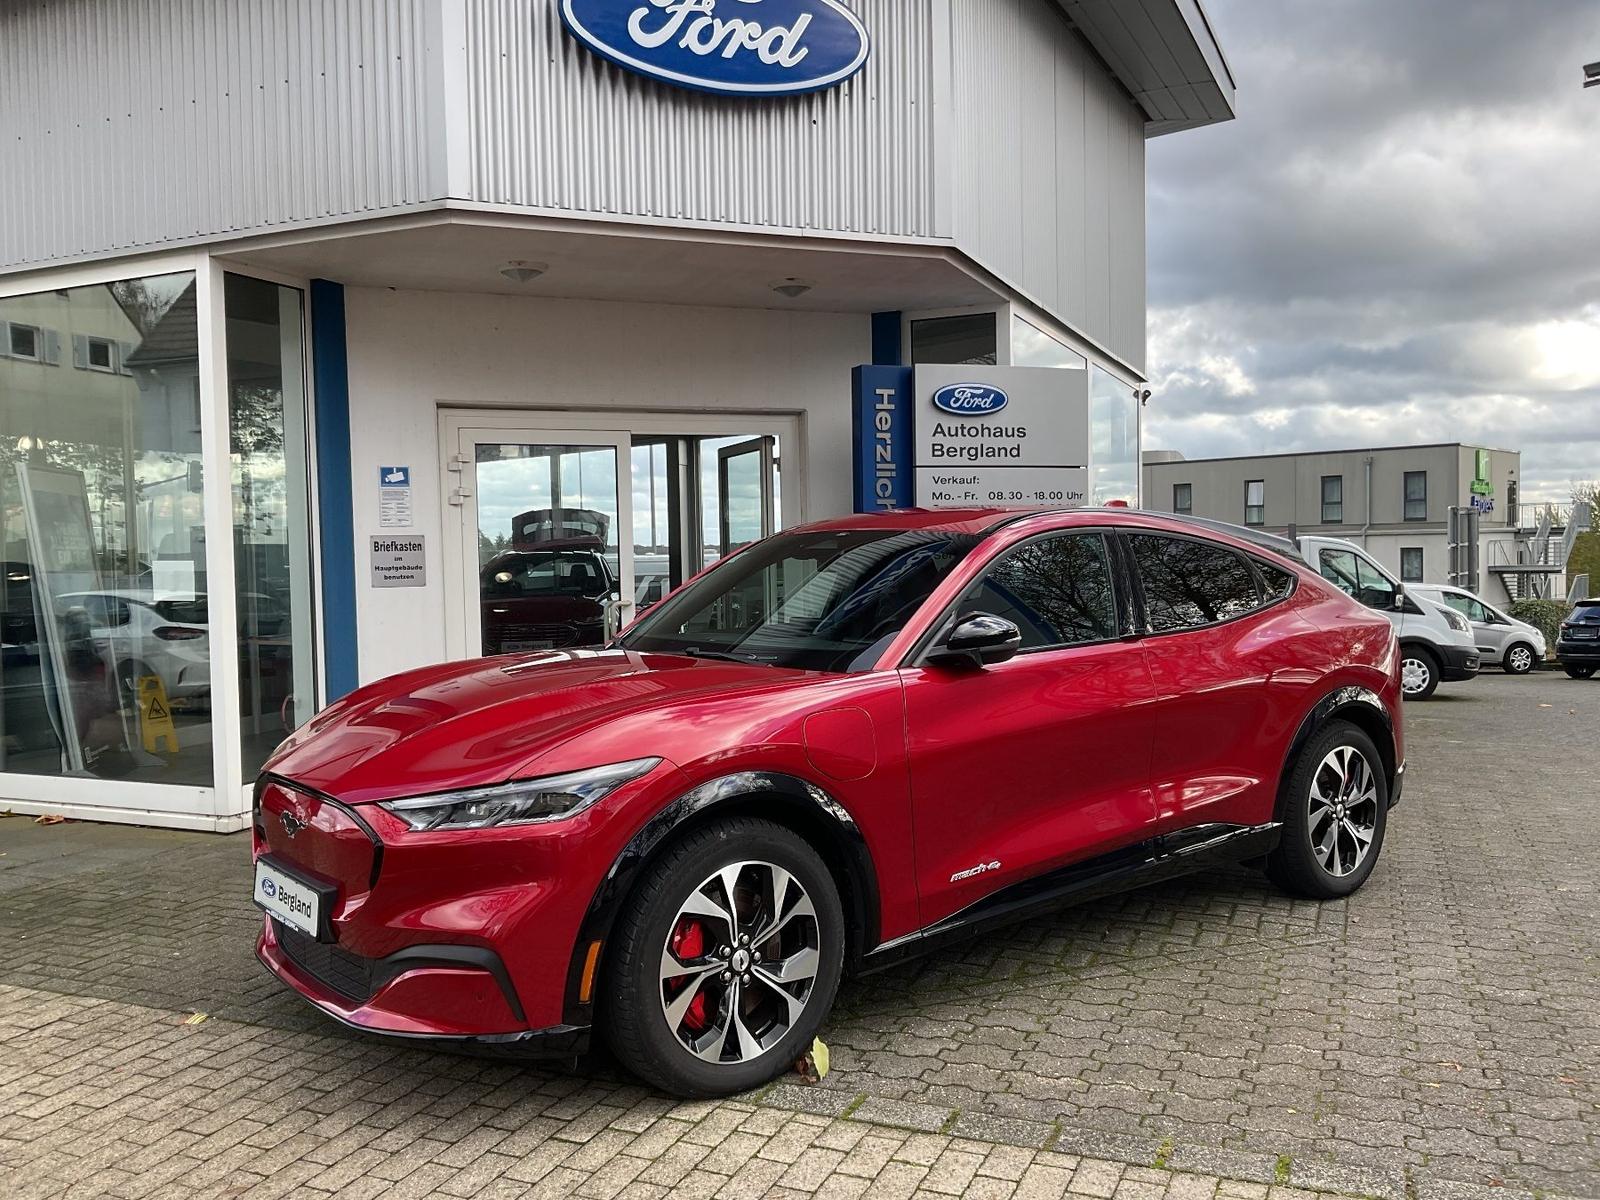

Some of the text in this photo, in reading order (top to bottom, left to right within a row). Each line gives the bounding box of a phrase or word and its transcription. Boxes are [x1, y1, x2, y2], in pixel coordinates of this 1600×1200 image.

[627, 0, 812, 68] Ford
[949, 387, 994, 408] Ford
[932, 422, 1027, 438] Autohaus
[931, 443, 1021, 461] Bergland
[932, 476, 980, 485] Verkauf:
[988, 491, 1023, 500] 08.30
[1034, 491, 1063, 500] 18.00
[1066, 491, 1083, 500] Uhr
[373, 541, 422, 552] Briefkasten
[279, 884, 312, 918] Bergland
